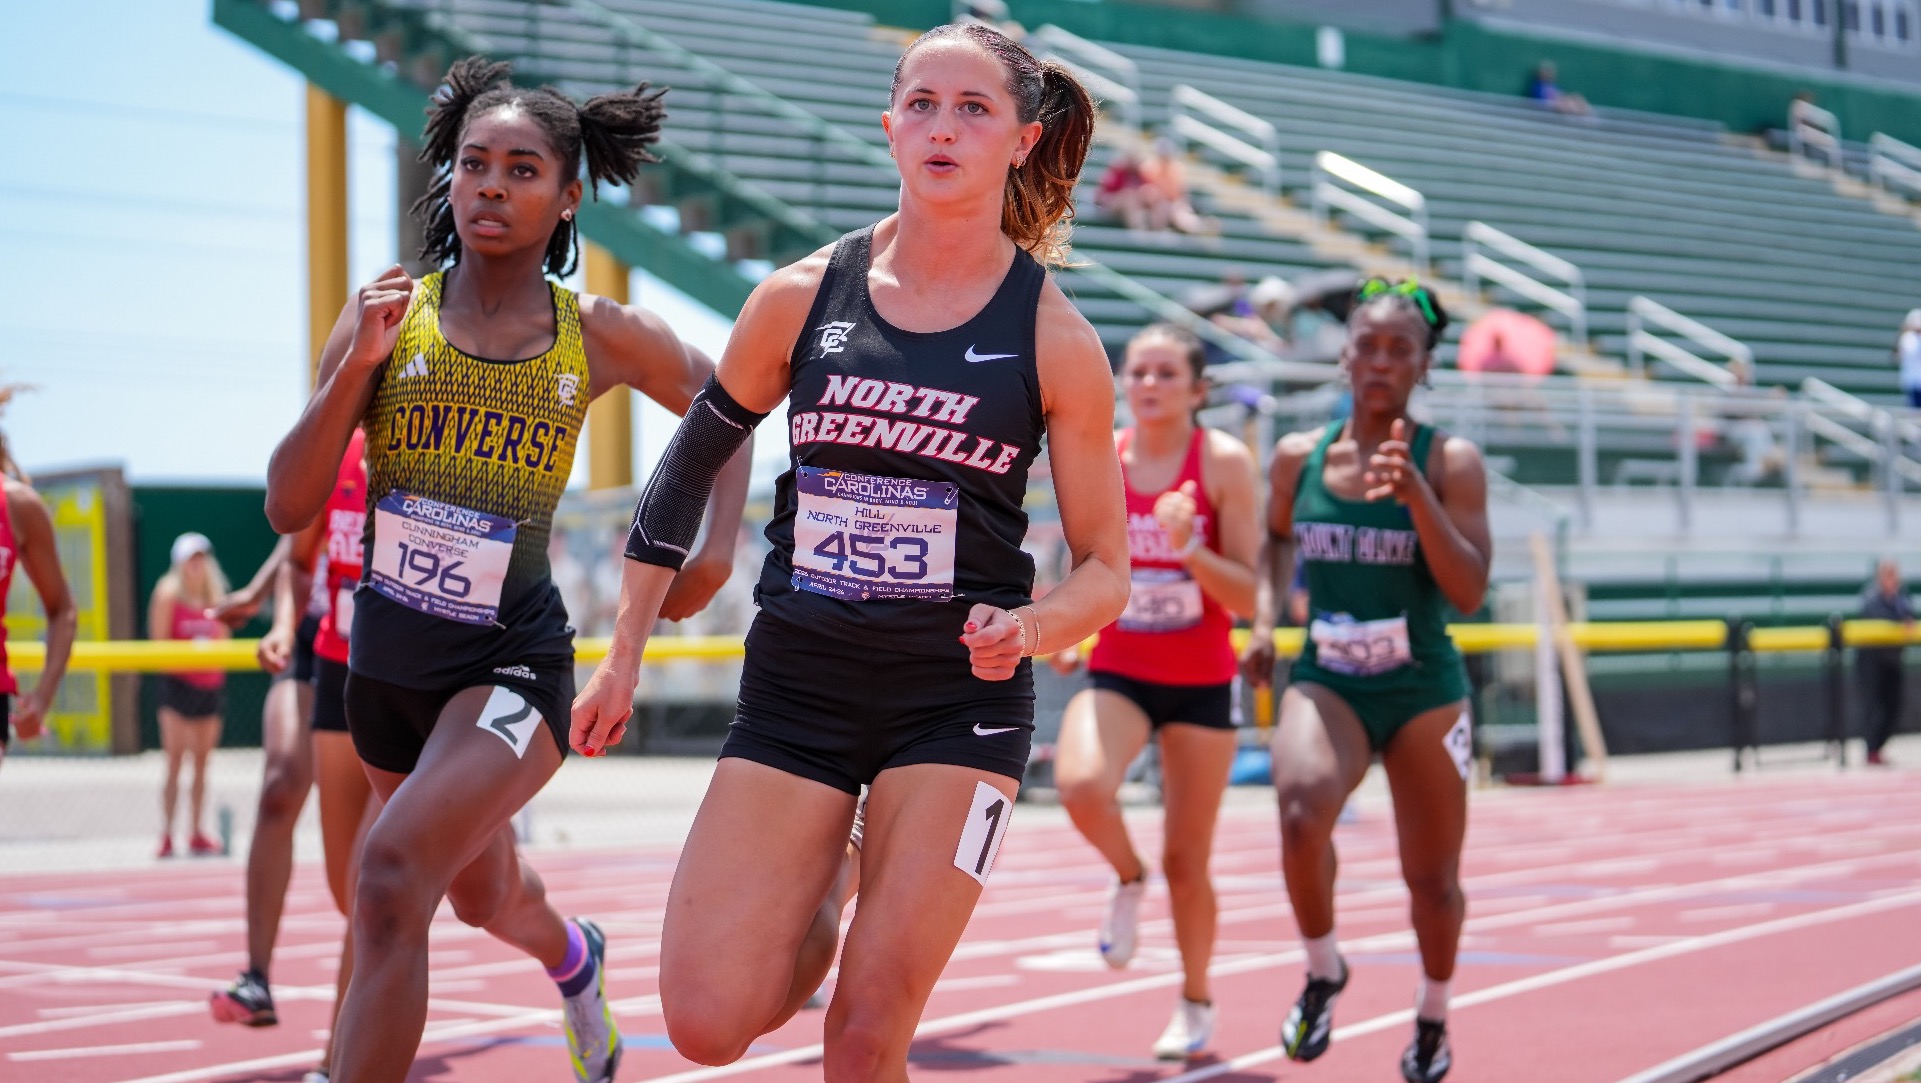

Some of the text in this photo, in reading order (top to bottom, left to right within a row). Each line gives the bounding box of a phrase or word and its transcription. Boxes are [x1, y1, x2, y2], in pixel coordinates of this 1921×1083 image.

[816, 375, 981, 425] NORTH
[387, 402, 568, 473] CONVERSE
[792, 412, 1021, 475] GREENVILLE
[824, 473, 928, 500] CAROLINAS
[844, 474, 912, 486] CONFERENCE
[402, 499, 492, 533] CAROLINAS
[421, 498, 481, 518] CONFERENCE
[854, 506, 885, 520] HILL
[402, 521, 479, 549] CUNNINGHAM
[807, 510, 942, 534] NORTH GREENVILLE
[408, 534, 469, 558] CONVERSE
[813, 530, 929, 580] 453
[398, 541, 471, 599] 196
[811, 574, 837, 584] OUTDOOR
[840, 580, 861, 589] TRACK
[809, 582, 827, 590] APRIL
[493, 665, 537, 680] adidas
[490, 690, 533, 746] 2
[975, 799, 1005, 875] 1
